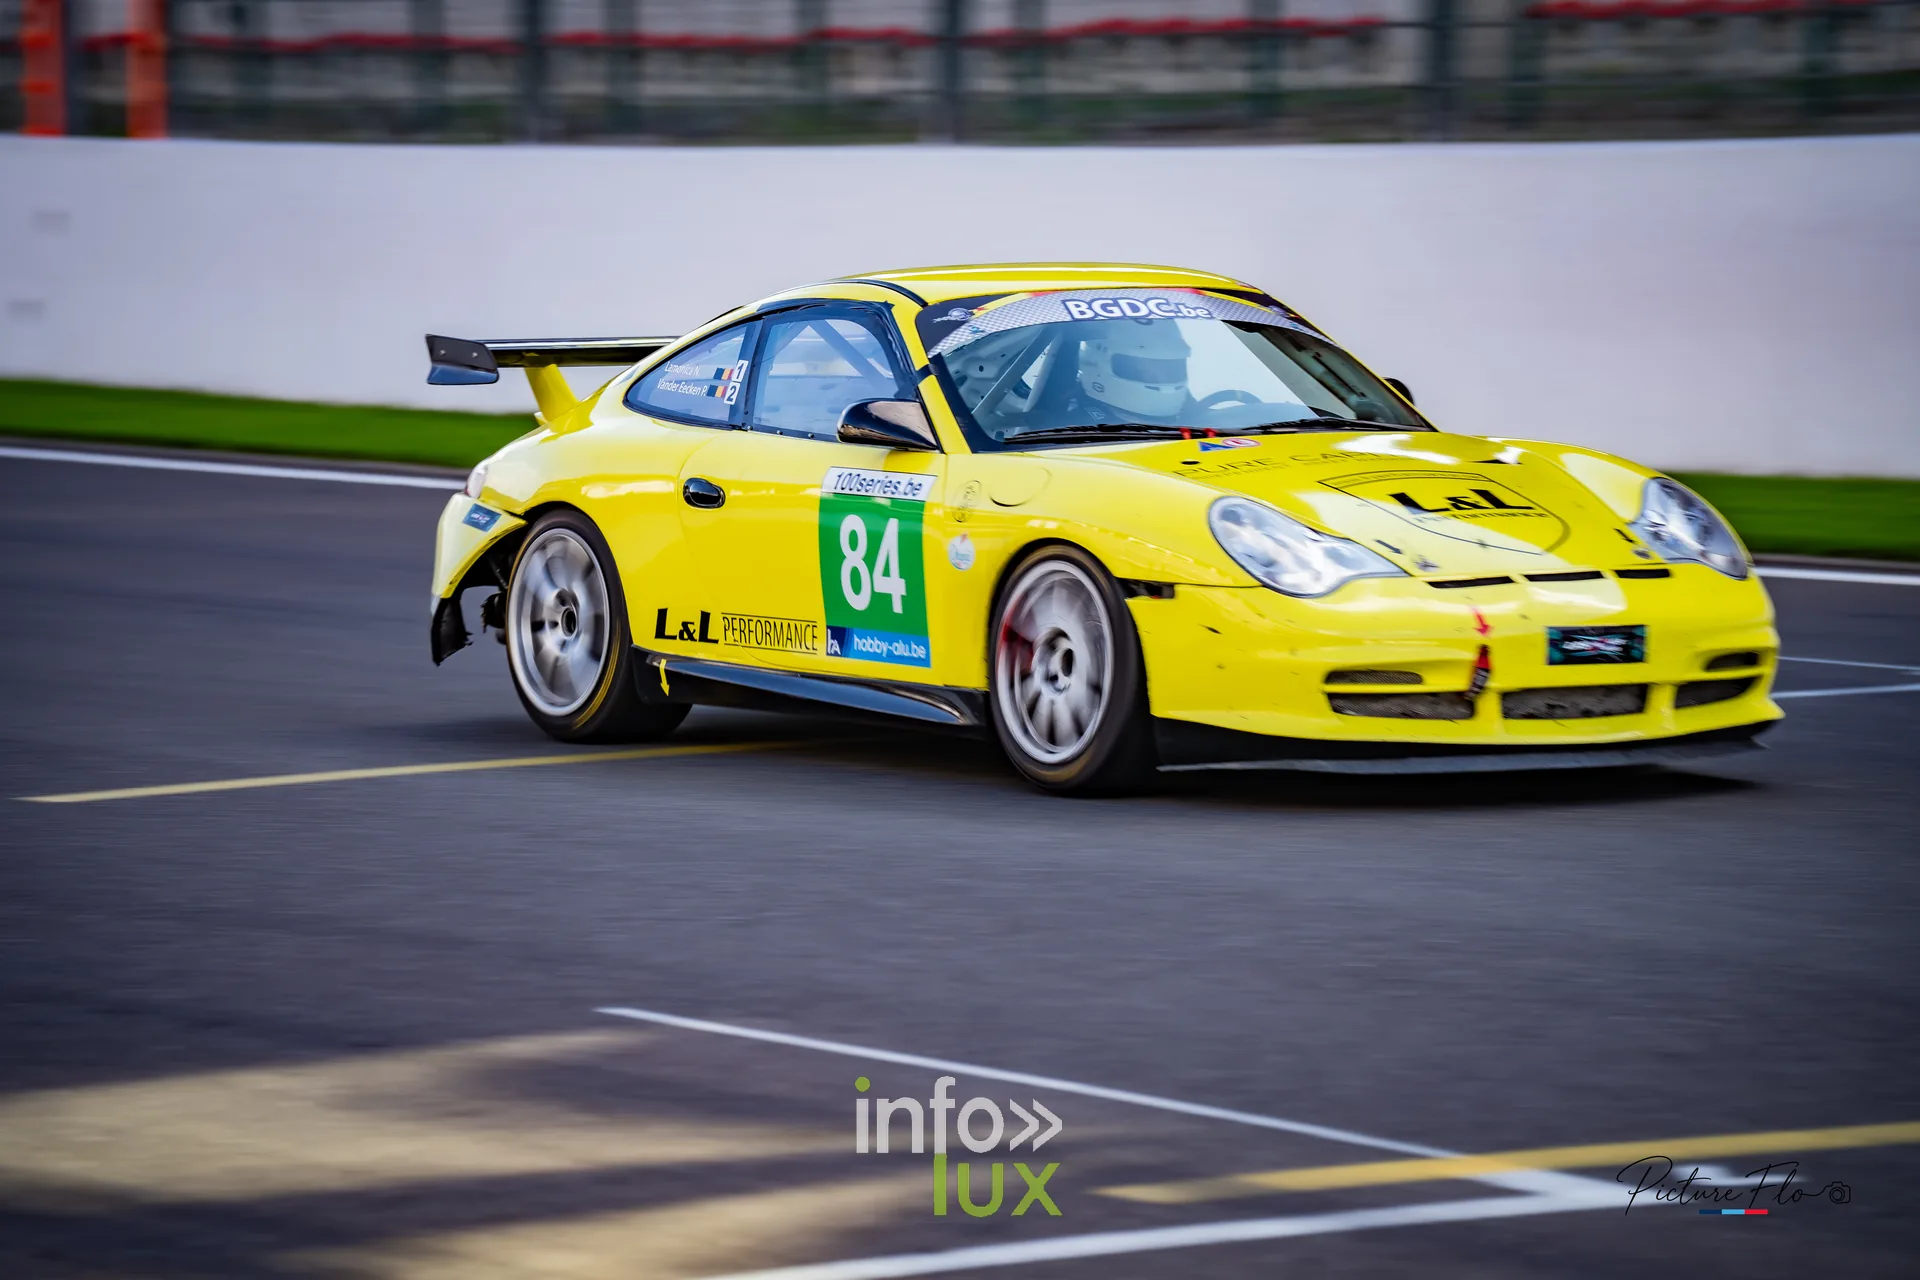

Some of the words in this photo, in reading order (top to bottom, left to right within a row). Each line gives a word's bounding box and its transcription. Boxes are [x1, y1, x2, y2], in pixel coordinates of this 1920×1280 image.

[1064, 298, 1213, 319] BGDC.be
[664, 361, 694, 376] Lamonica
[735, 362, 745, 378] 1
[657, 379, 680, 392] Vander
[678, 381, 701, 396] Eecken
[726, 385, 738, 403] 2
[833, 471, 923, 497] 100series.be
[1388, 488, 1535, 514] L&L
[839, 514, 907, 614] 84
[654, 608, 720, 644] L&L
[722, 615, 818, 651] PERFORMANCE
[853, 634, 927, 659] hobby-alu.be
